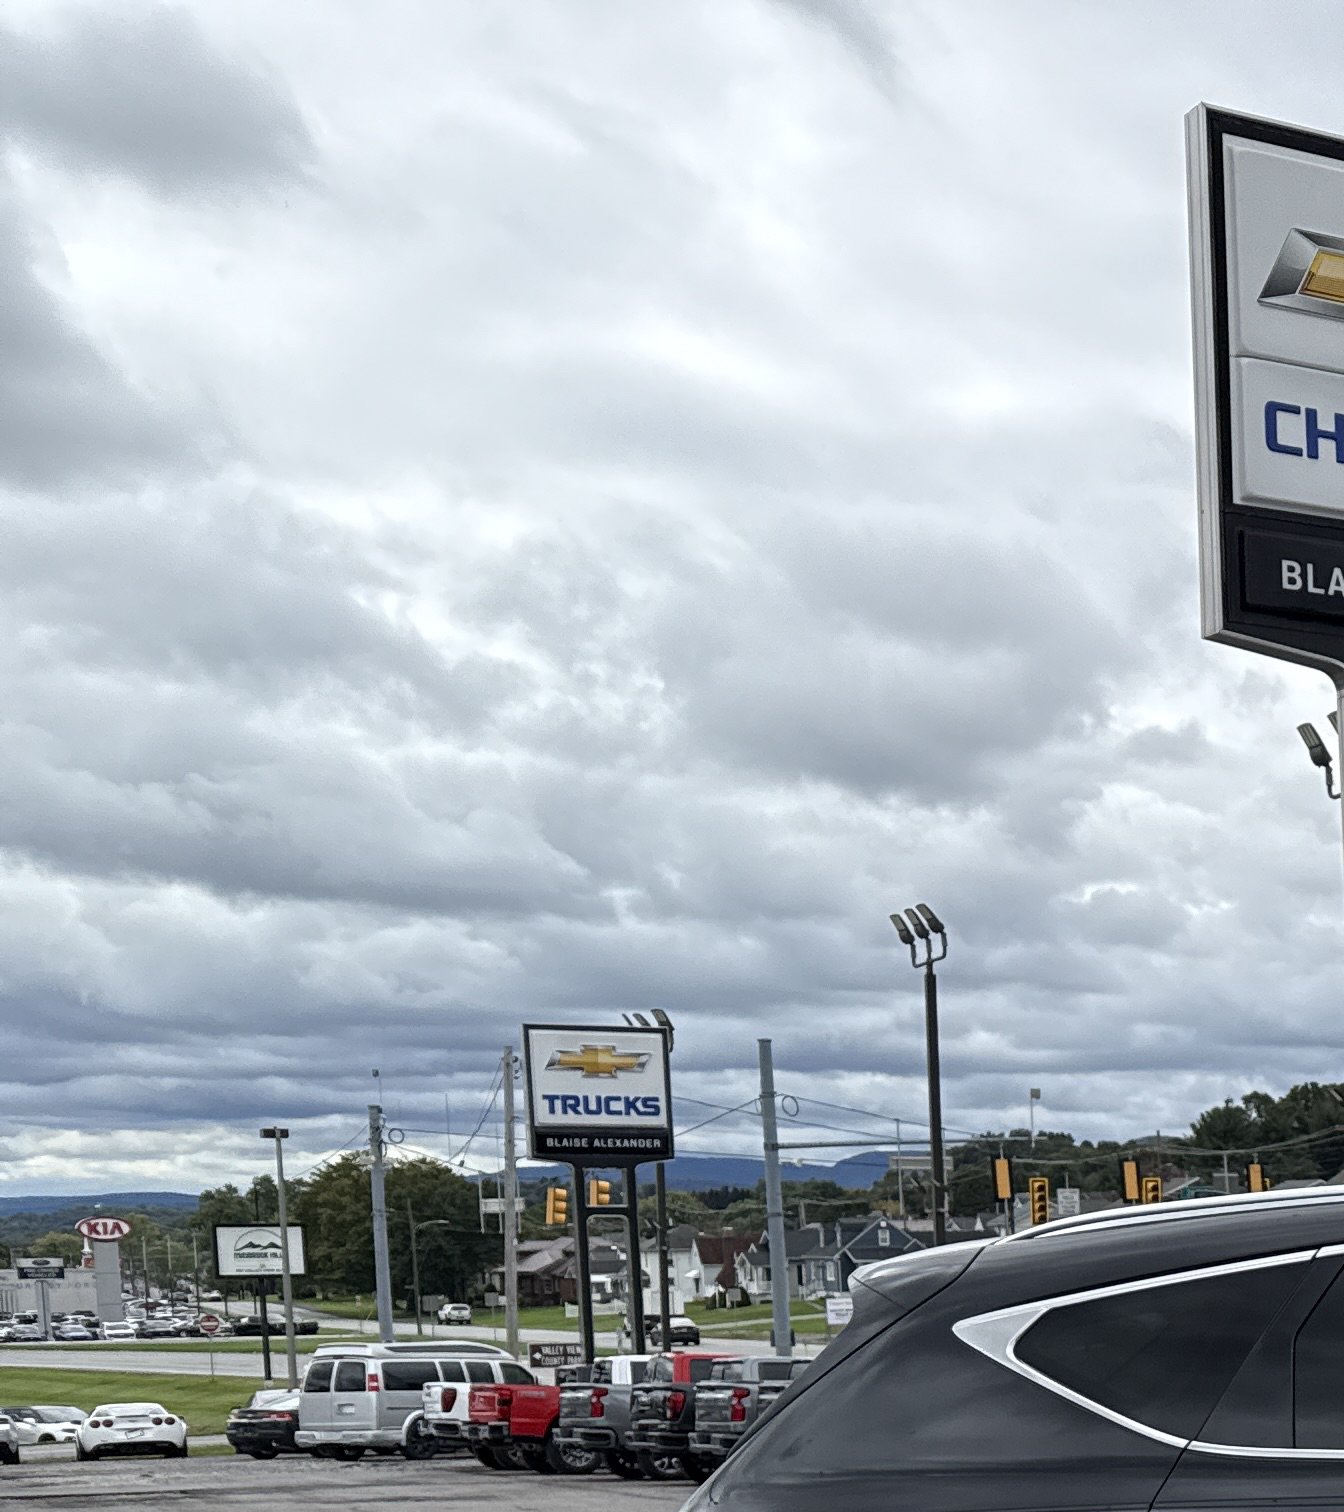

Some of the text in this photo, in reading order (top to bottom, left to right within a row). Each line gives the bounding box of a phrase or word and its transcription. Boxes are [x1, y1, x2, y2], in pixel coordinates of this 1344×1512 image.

[543, 1094, 660, 1116] TRUCKS
[546, 1138, 661, 1148] BLAISE ALEXANDER
[86, 1222, 124, 1235] KIA
